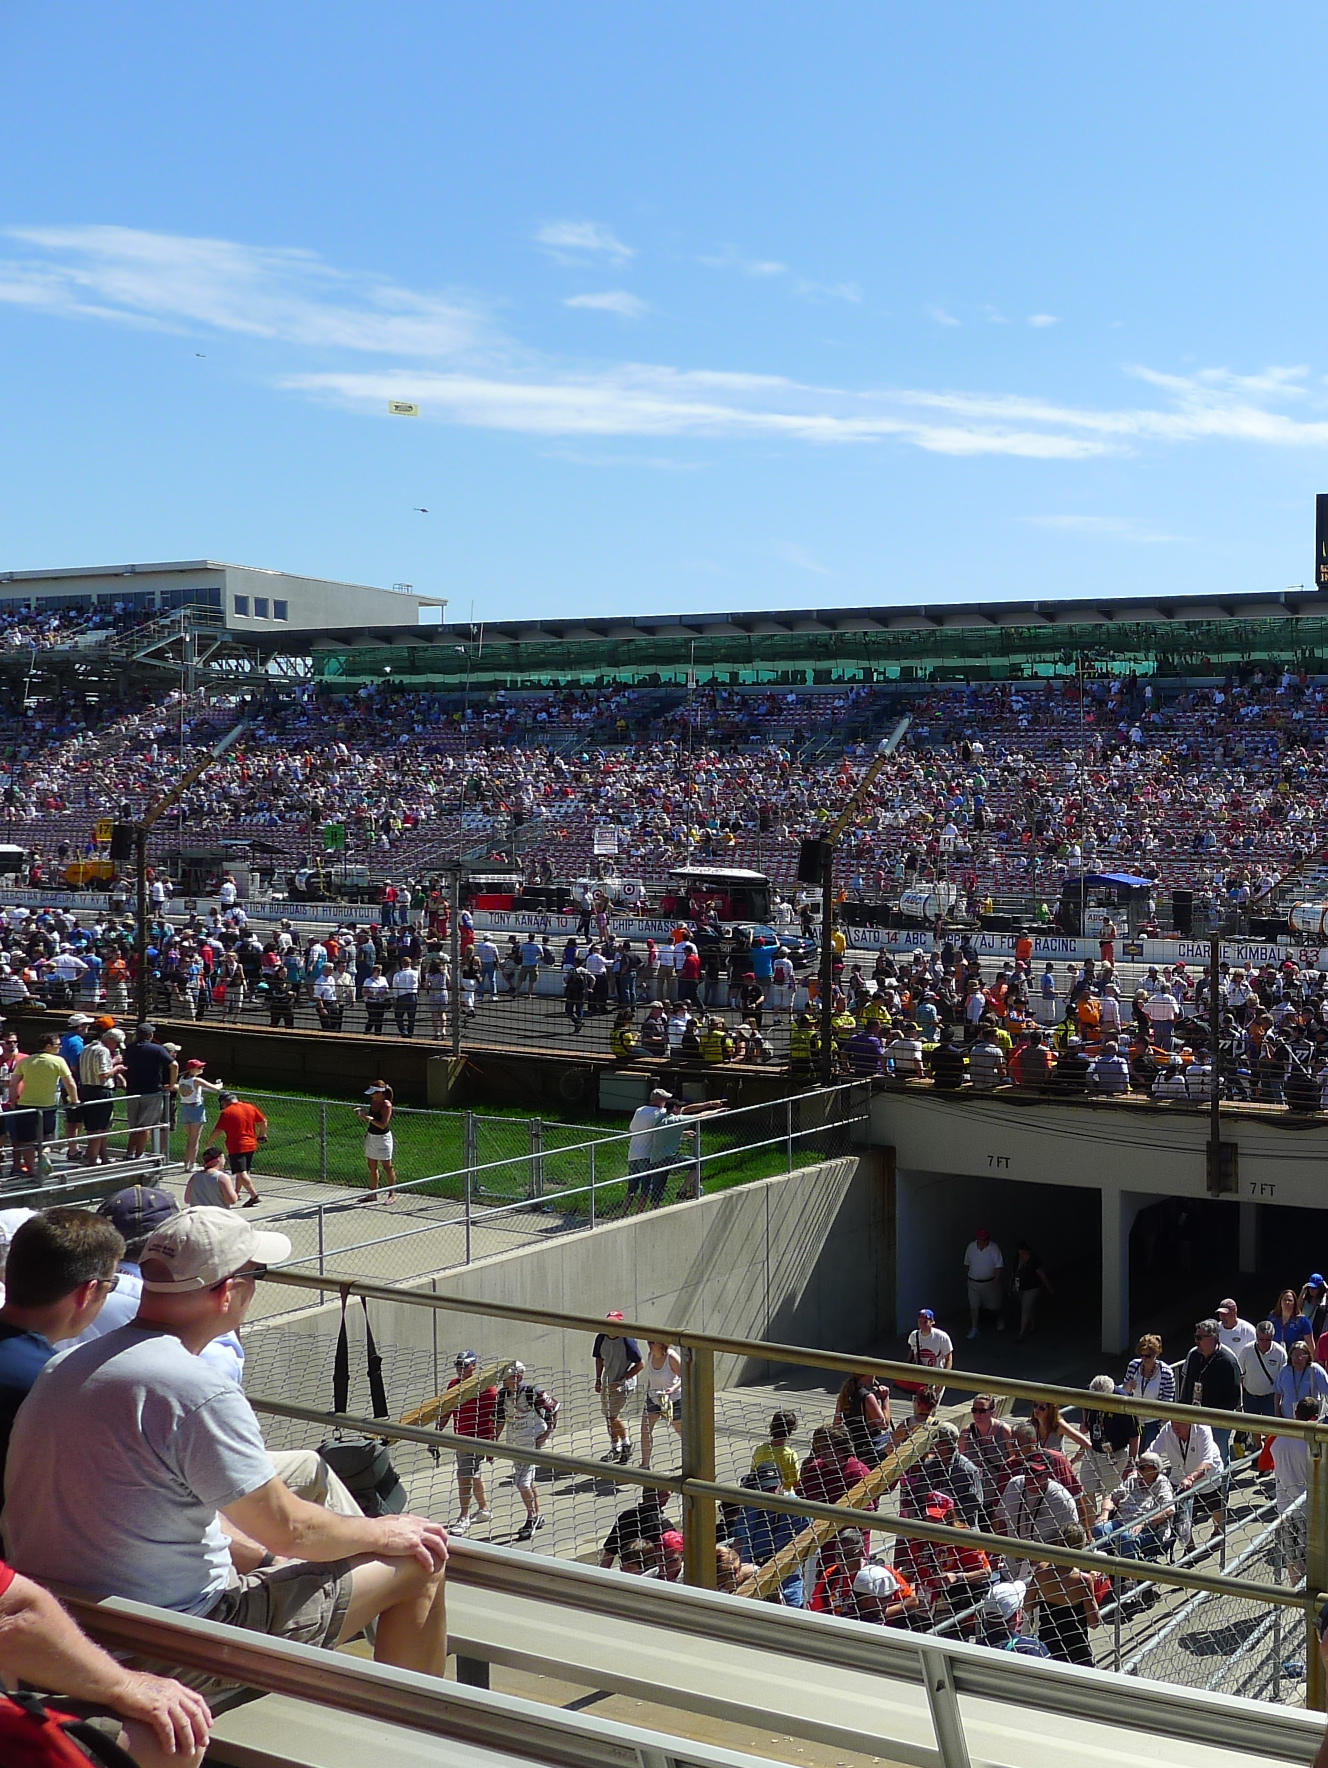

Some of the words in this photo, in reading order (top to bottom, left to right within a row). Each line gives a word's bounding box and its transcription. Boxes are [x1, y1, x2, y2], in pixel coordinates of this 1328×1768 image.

[488, 911, 512, 925] TONY
[515, 912, 552, 927] KANAAN
[613, 918, 634, 931] CHIP
[853, 931, 881, 945] SATO
[904, 931, 927, 945] ABC
[1034, 937, 1077, 952] RACING
[1178, 943, 1231, 959] CHARIE
[1298, 949, 1320, 963] 83
[987, 1155, 994, 1168] 7
[996, 1156, 1011, 1169] FT
[1250, 1182, 1257, 1195] 7
[1260, 1183, 1276, 1196] FT
